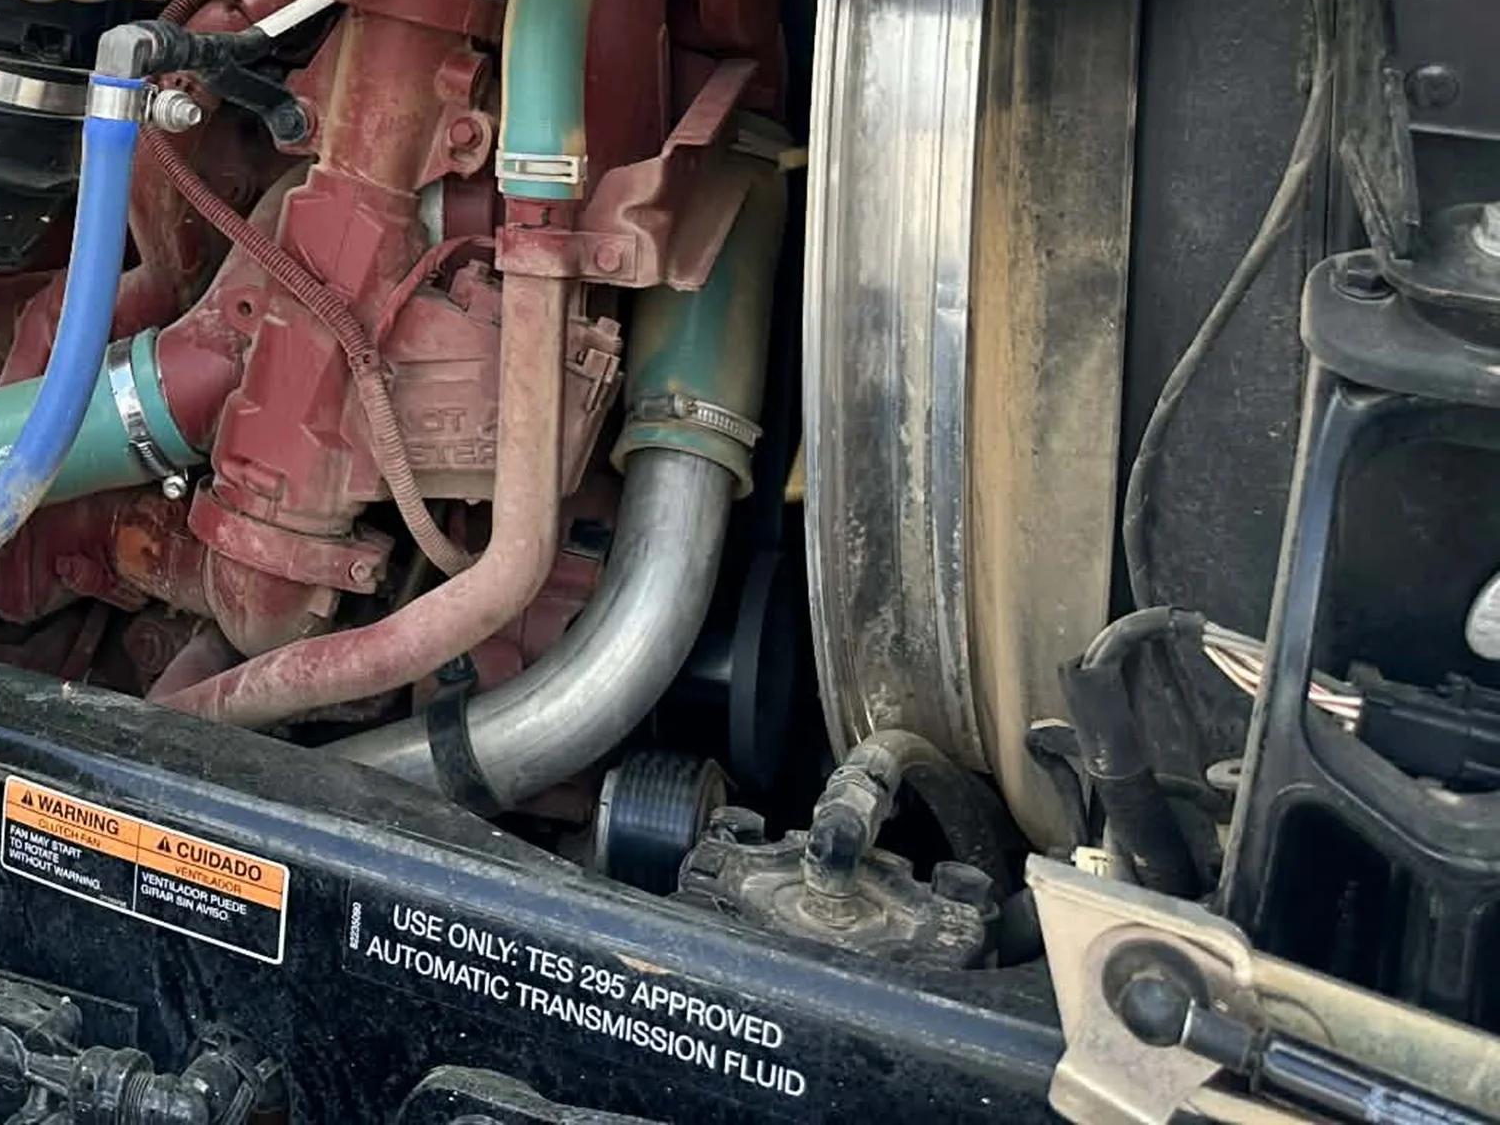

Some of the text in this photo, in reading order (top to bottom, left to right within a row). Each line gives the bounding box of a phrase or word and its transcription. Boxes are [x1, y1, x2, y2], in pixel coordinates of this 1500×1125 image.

[37, 794, 119, 836] WARNING
[10, 825, 82, 859] FAN MAY START
[38, 818, 100, 849] CLUTCH FAN
[9, 849, 55, 873] WITHOUT
[10, 838, 60, 864] TO ROTATE
[176, 842, 262, 882] CUIDADO
[140, 885, 174, 905] GIRAR
[176, 895, 194, 910] SIN
[141, 871, 208, 902] VENTILADOR
[210, 894, 247, 915] PUEDE
[174, 866, 242, 895] VENTILADOR
[393, 904, 783, 1049] USE ONLY: TES 295 APPROVED
[365, 936, 807, 1098] AUTOMATIC TRANSMISSION FLUID
